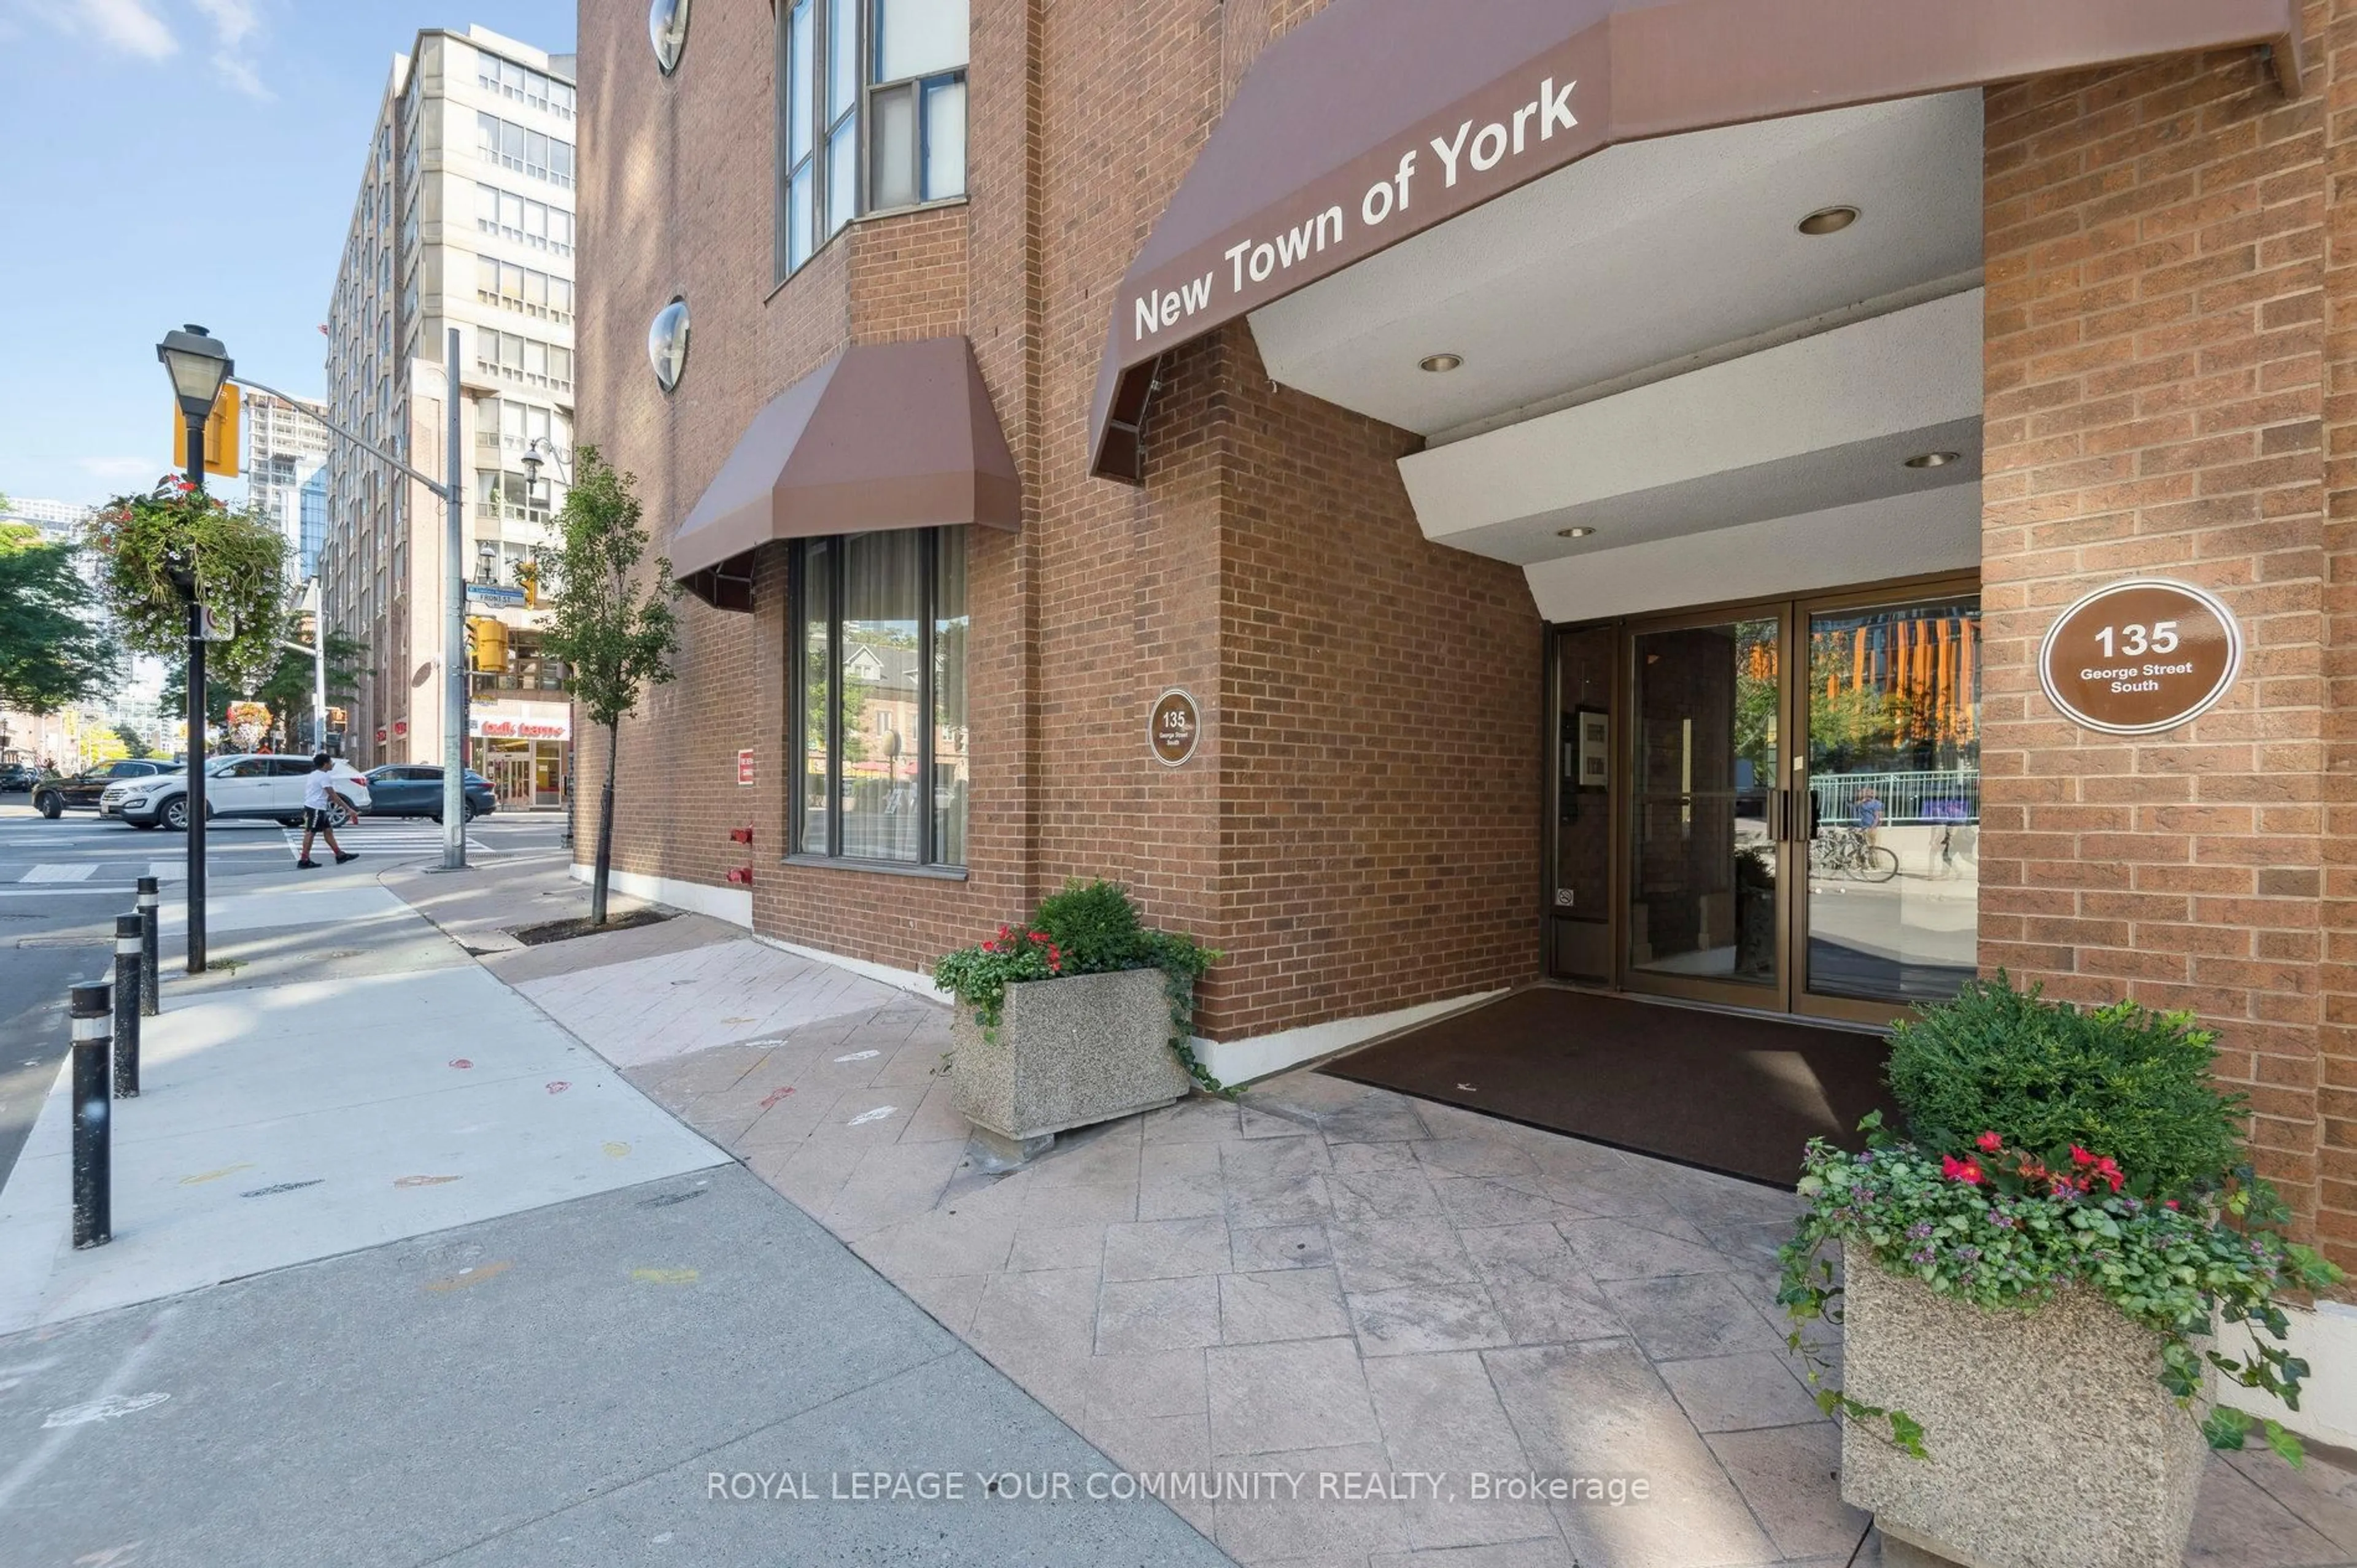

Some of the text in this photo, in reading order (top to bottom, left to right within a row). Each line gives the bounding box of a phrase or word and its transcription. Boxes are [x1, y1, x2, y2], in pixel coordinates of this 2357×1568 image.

[1135, 77, 1579, 341] New Town of York
[2094, 620, 2179, 658] 135
[2081, 662, 2193, 680] George Street
[2110, 679, 2159, 693] South
[1164, 711, 1185, 728] 135
